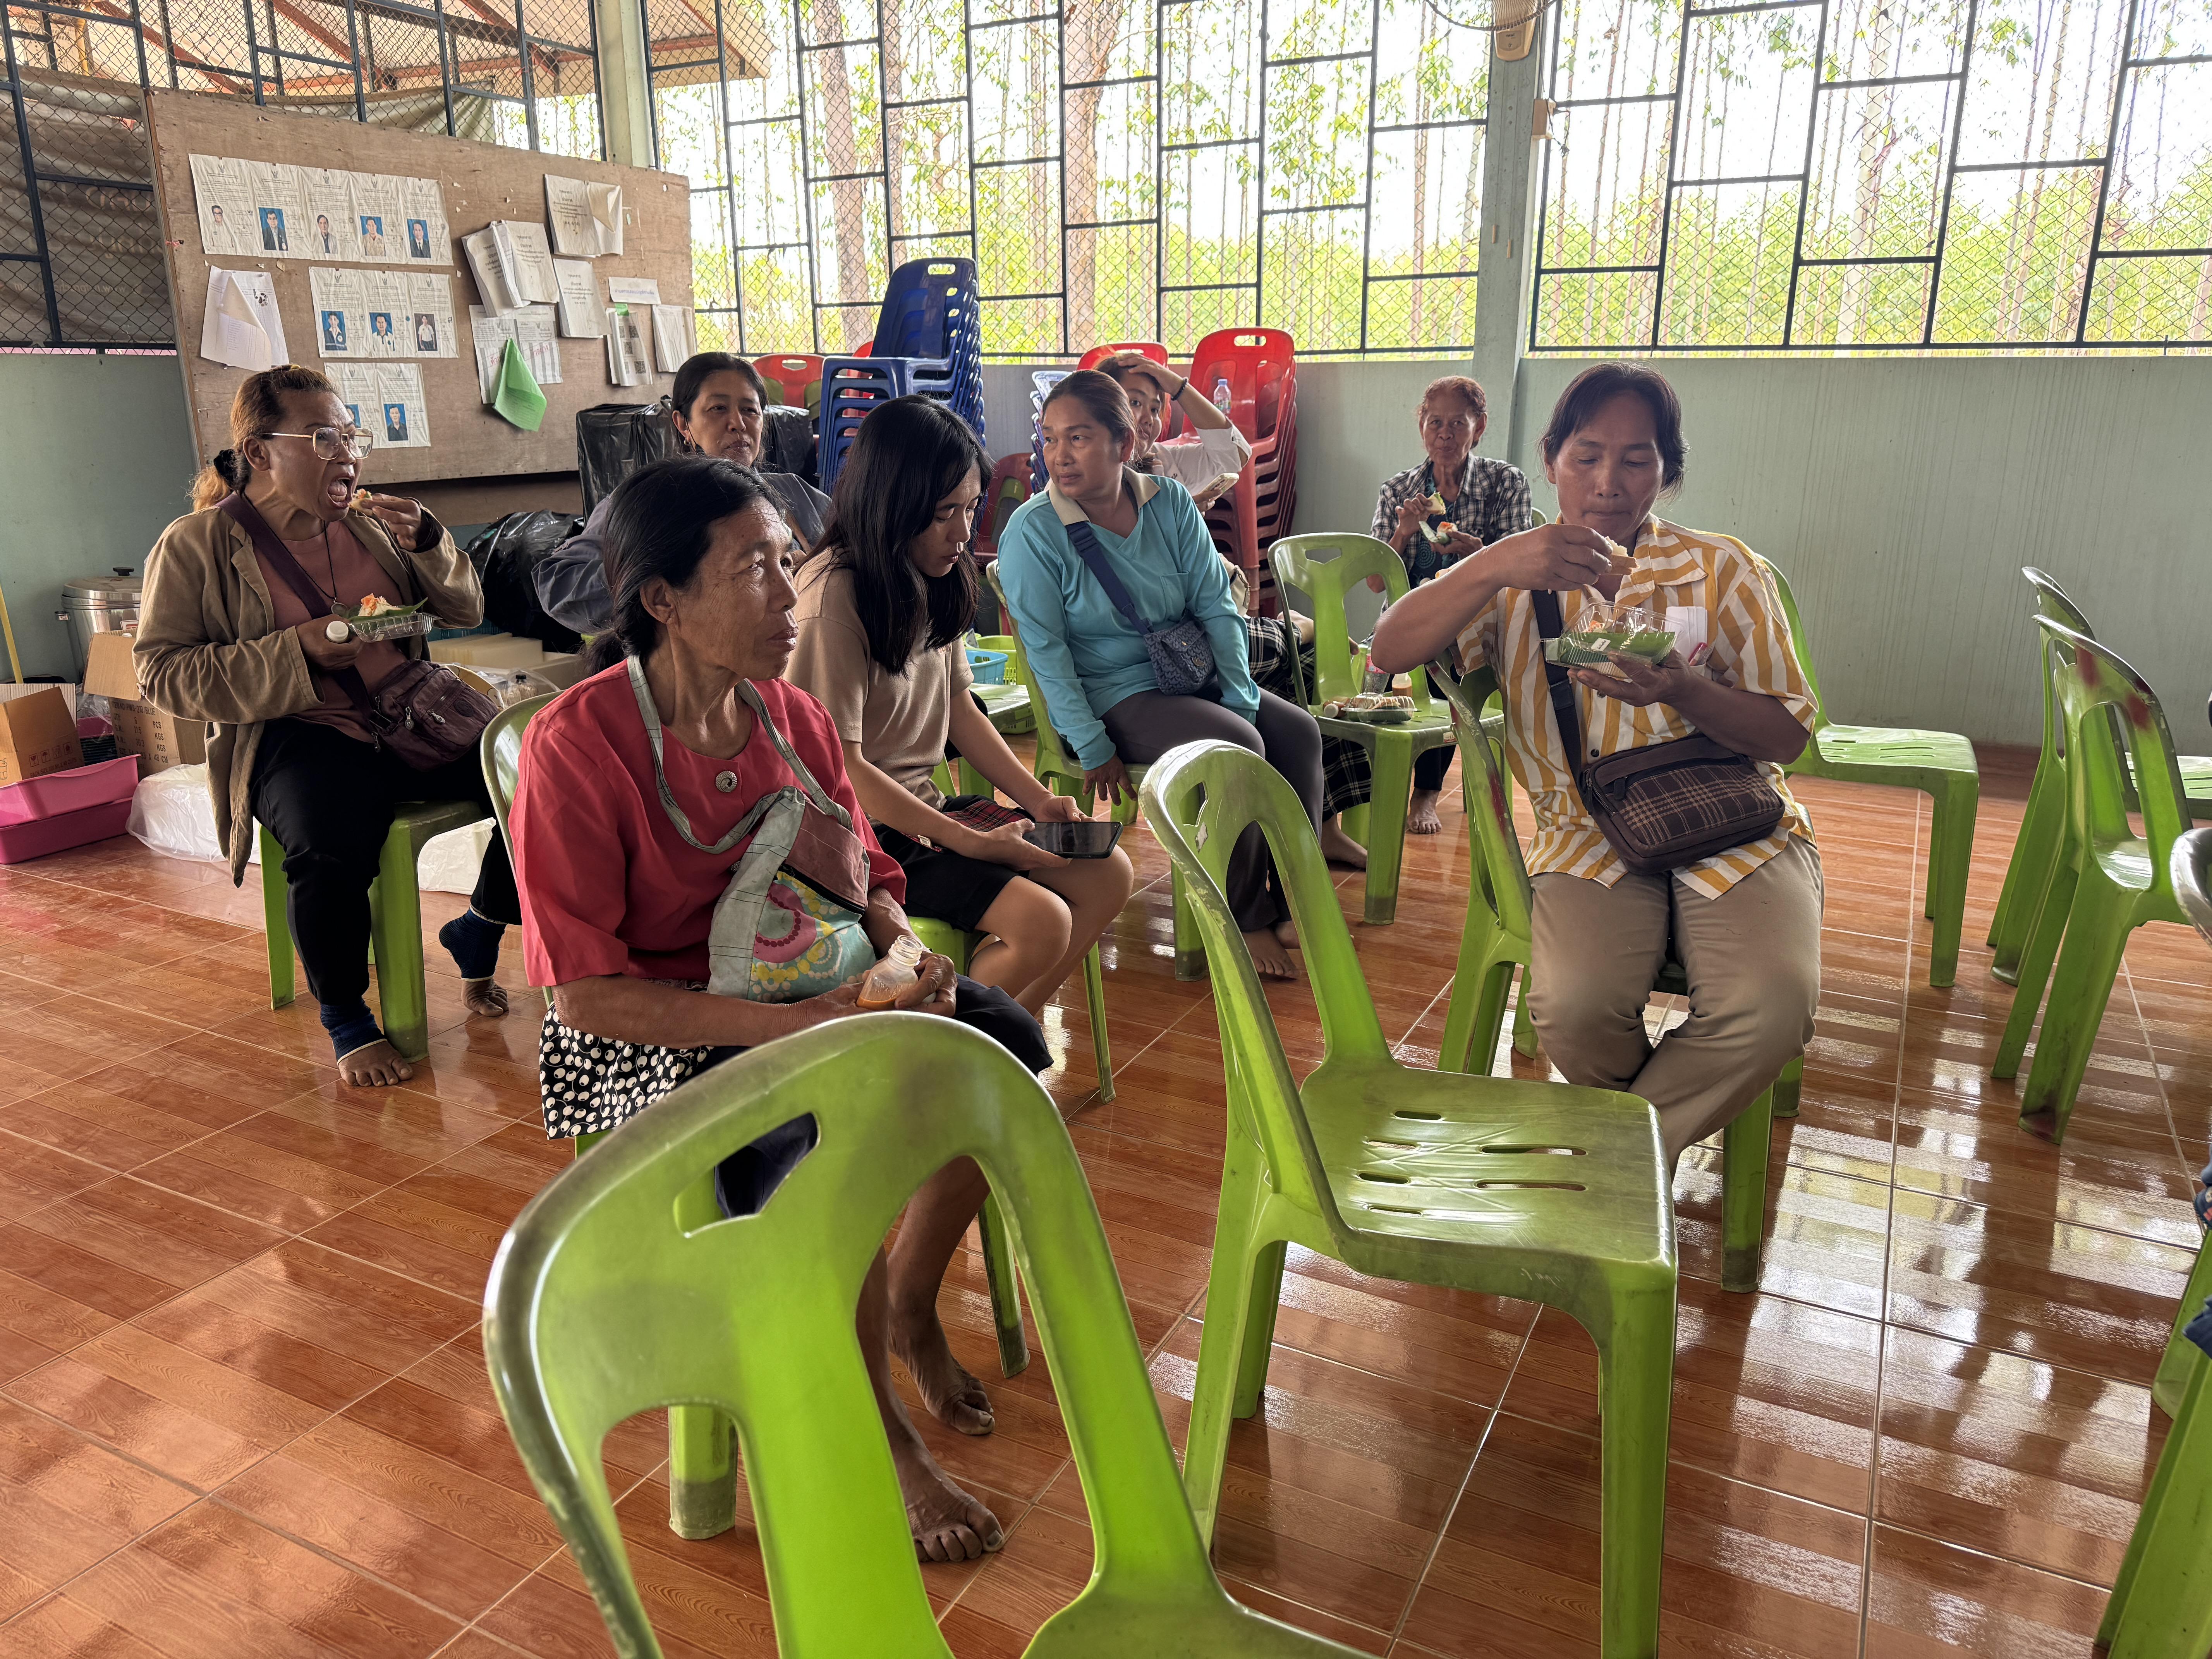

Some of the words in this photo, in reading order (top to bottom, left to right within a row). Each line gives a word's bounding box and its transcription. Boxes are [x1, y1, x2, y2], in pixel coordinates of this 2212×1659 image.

[153, 721, 162, 729] PCS
[155, 733, 164, 741] KGS
[157, 744, 166, 752] KGS
[161, 755, 169, 764] CM
